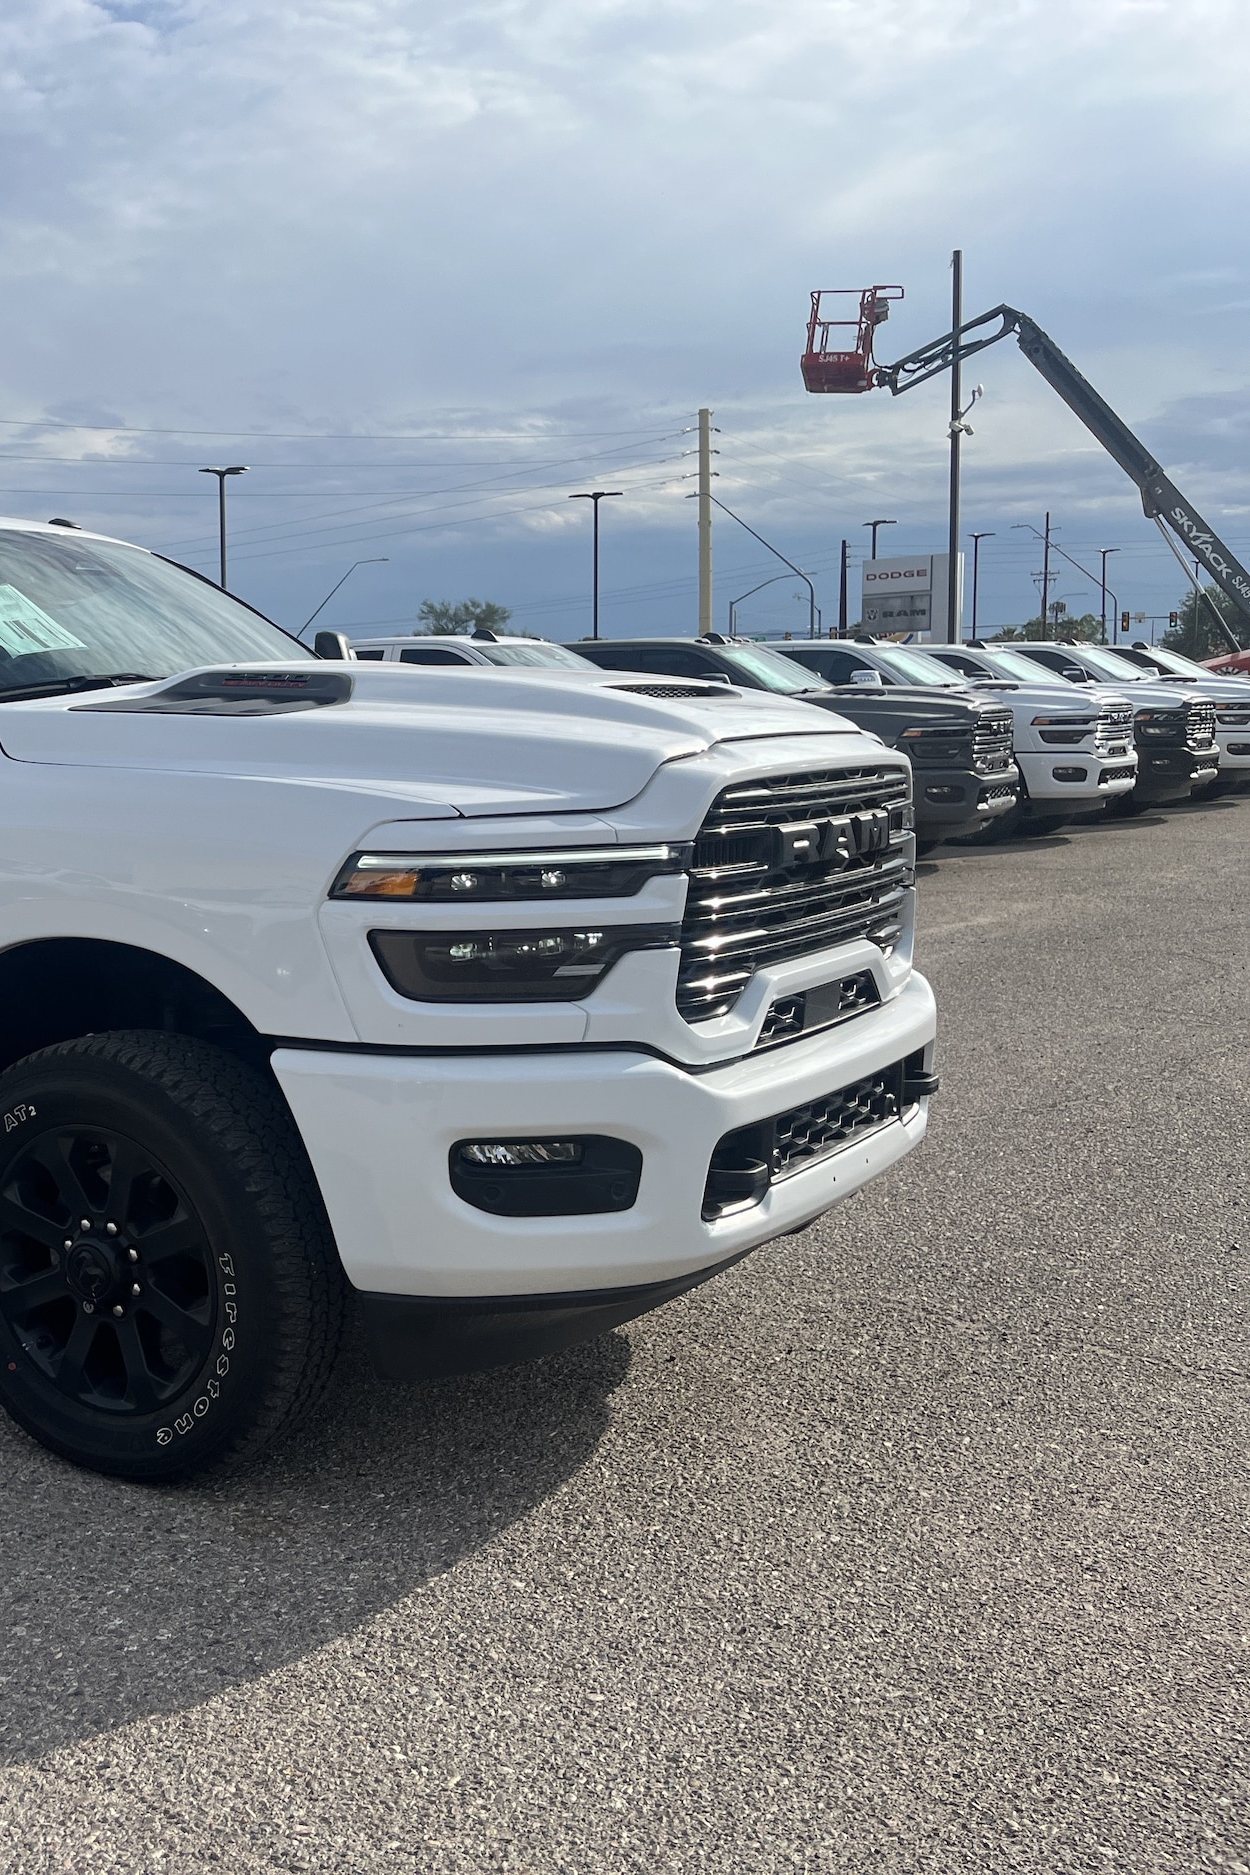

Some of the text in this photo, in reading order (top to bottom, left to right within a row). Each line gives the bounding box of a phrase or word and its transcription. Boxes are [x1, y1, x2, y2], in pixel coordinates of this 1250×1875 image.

[1171, 507, 1232, 579] SKYJACK
[866, 569, 928, 581] DODGE
[882, 609, 926, 618] RAM
[778, 808, 889, 865] RAM
